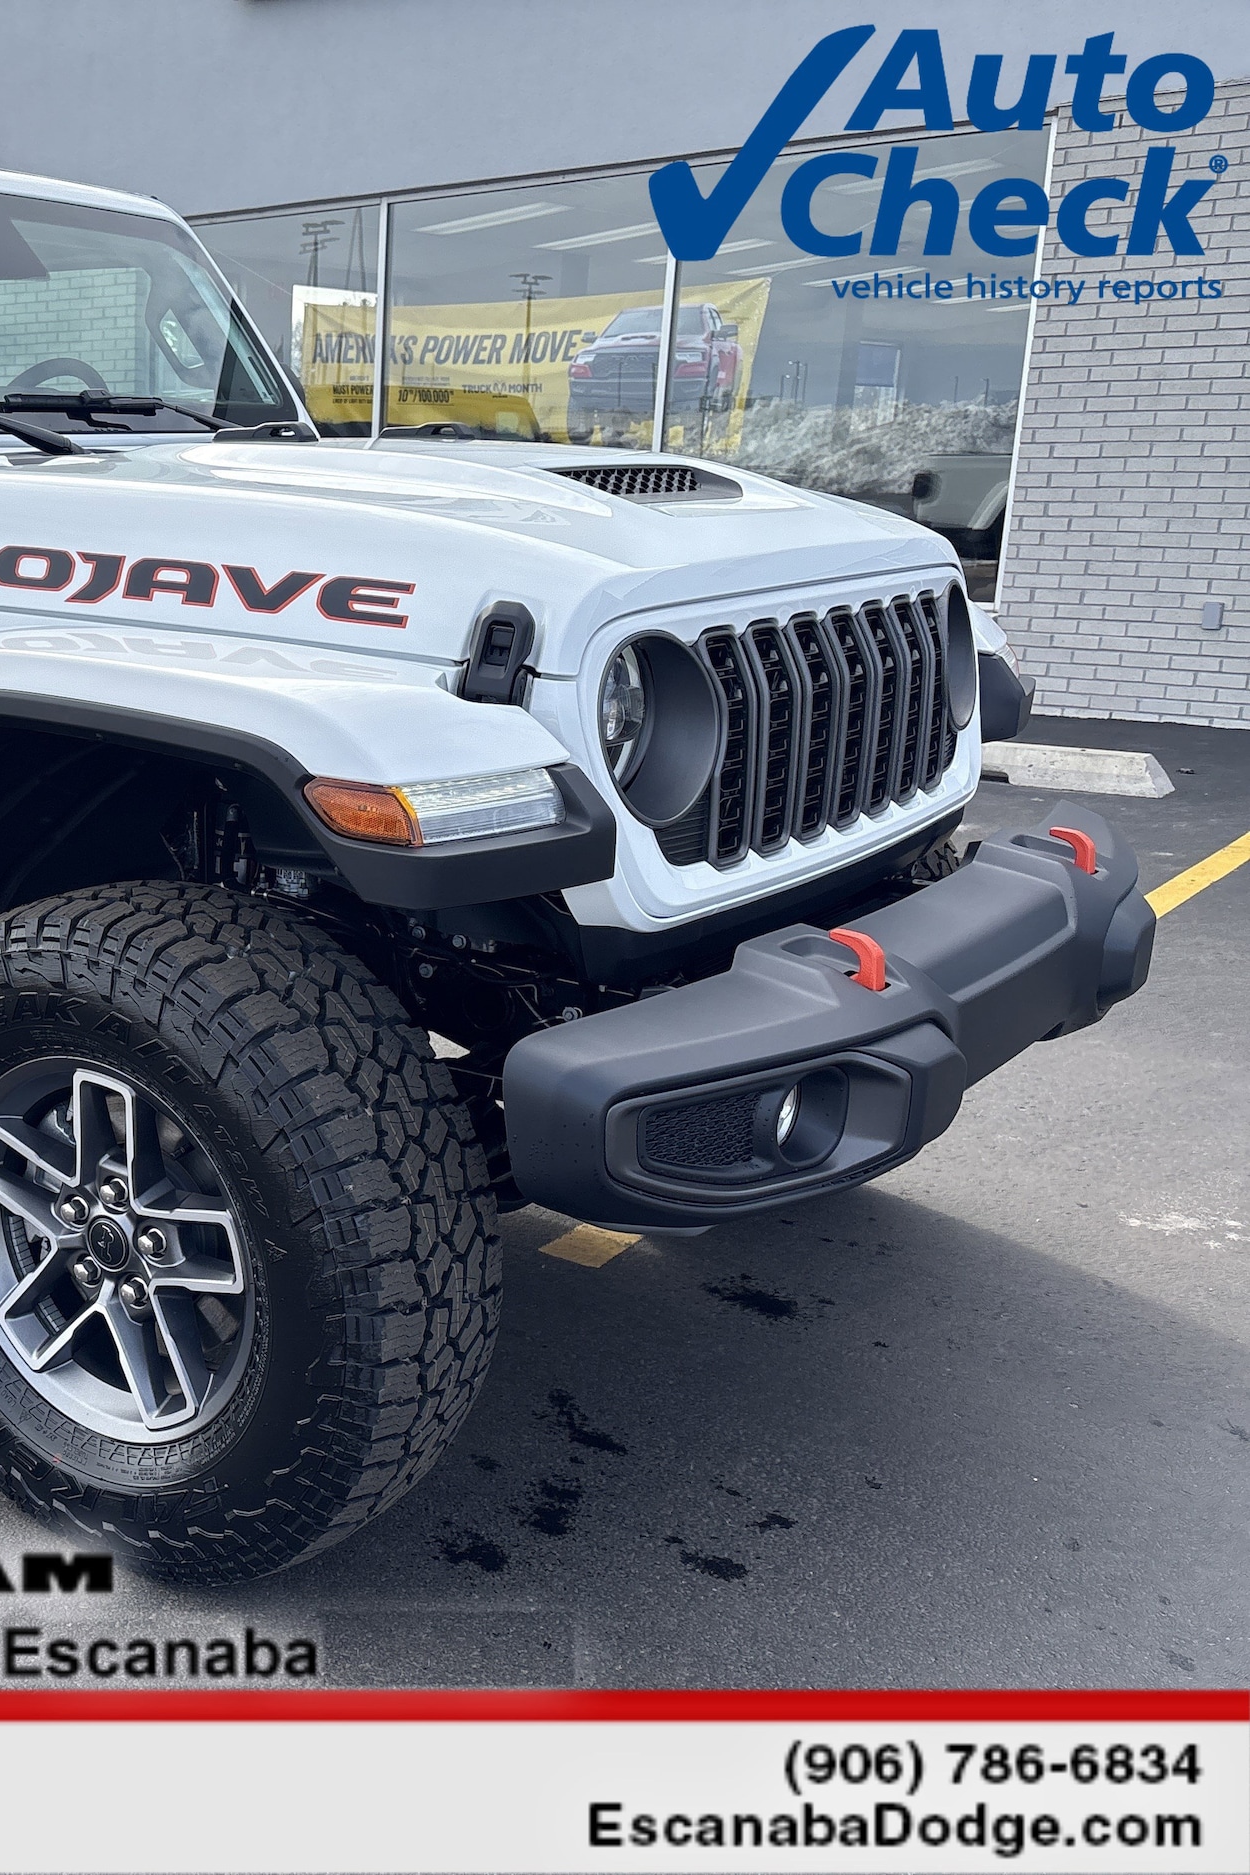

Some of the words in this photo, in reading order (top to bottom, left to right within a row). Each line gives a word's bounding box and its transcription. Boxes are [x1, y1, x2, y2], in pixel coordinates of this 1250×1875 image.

[312, 331, 418, 366] AMERIA'S
[419, 334, 508, 366] POWER
[508, 330, 583, 364] MOVE
[461, 384, 492, 394] TRUCK
[508, 383, 543, 393] MONTH
